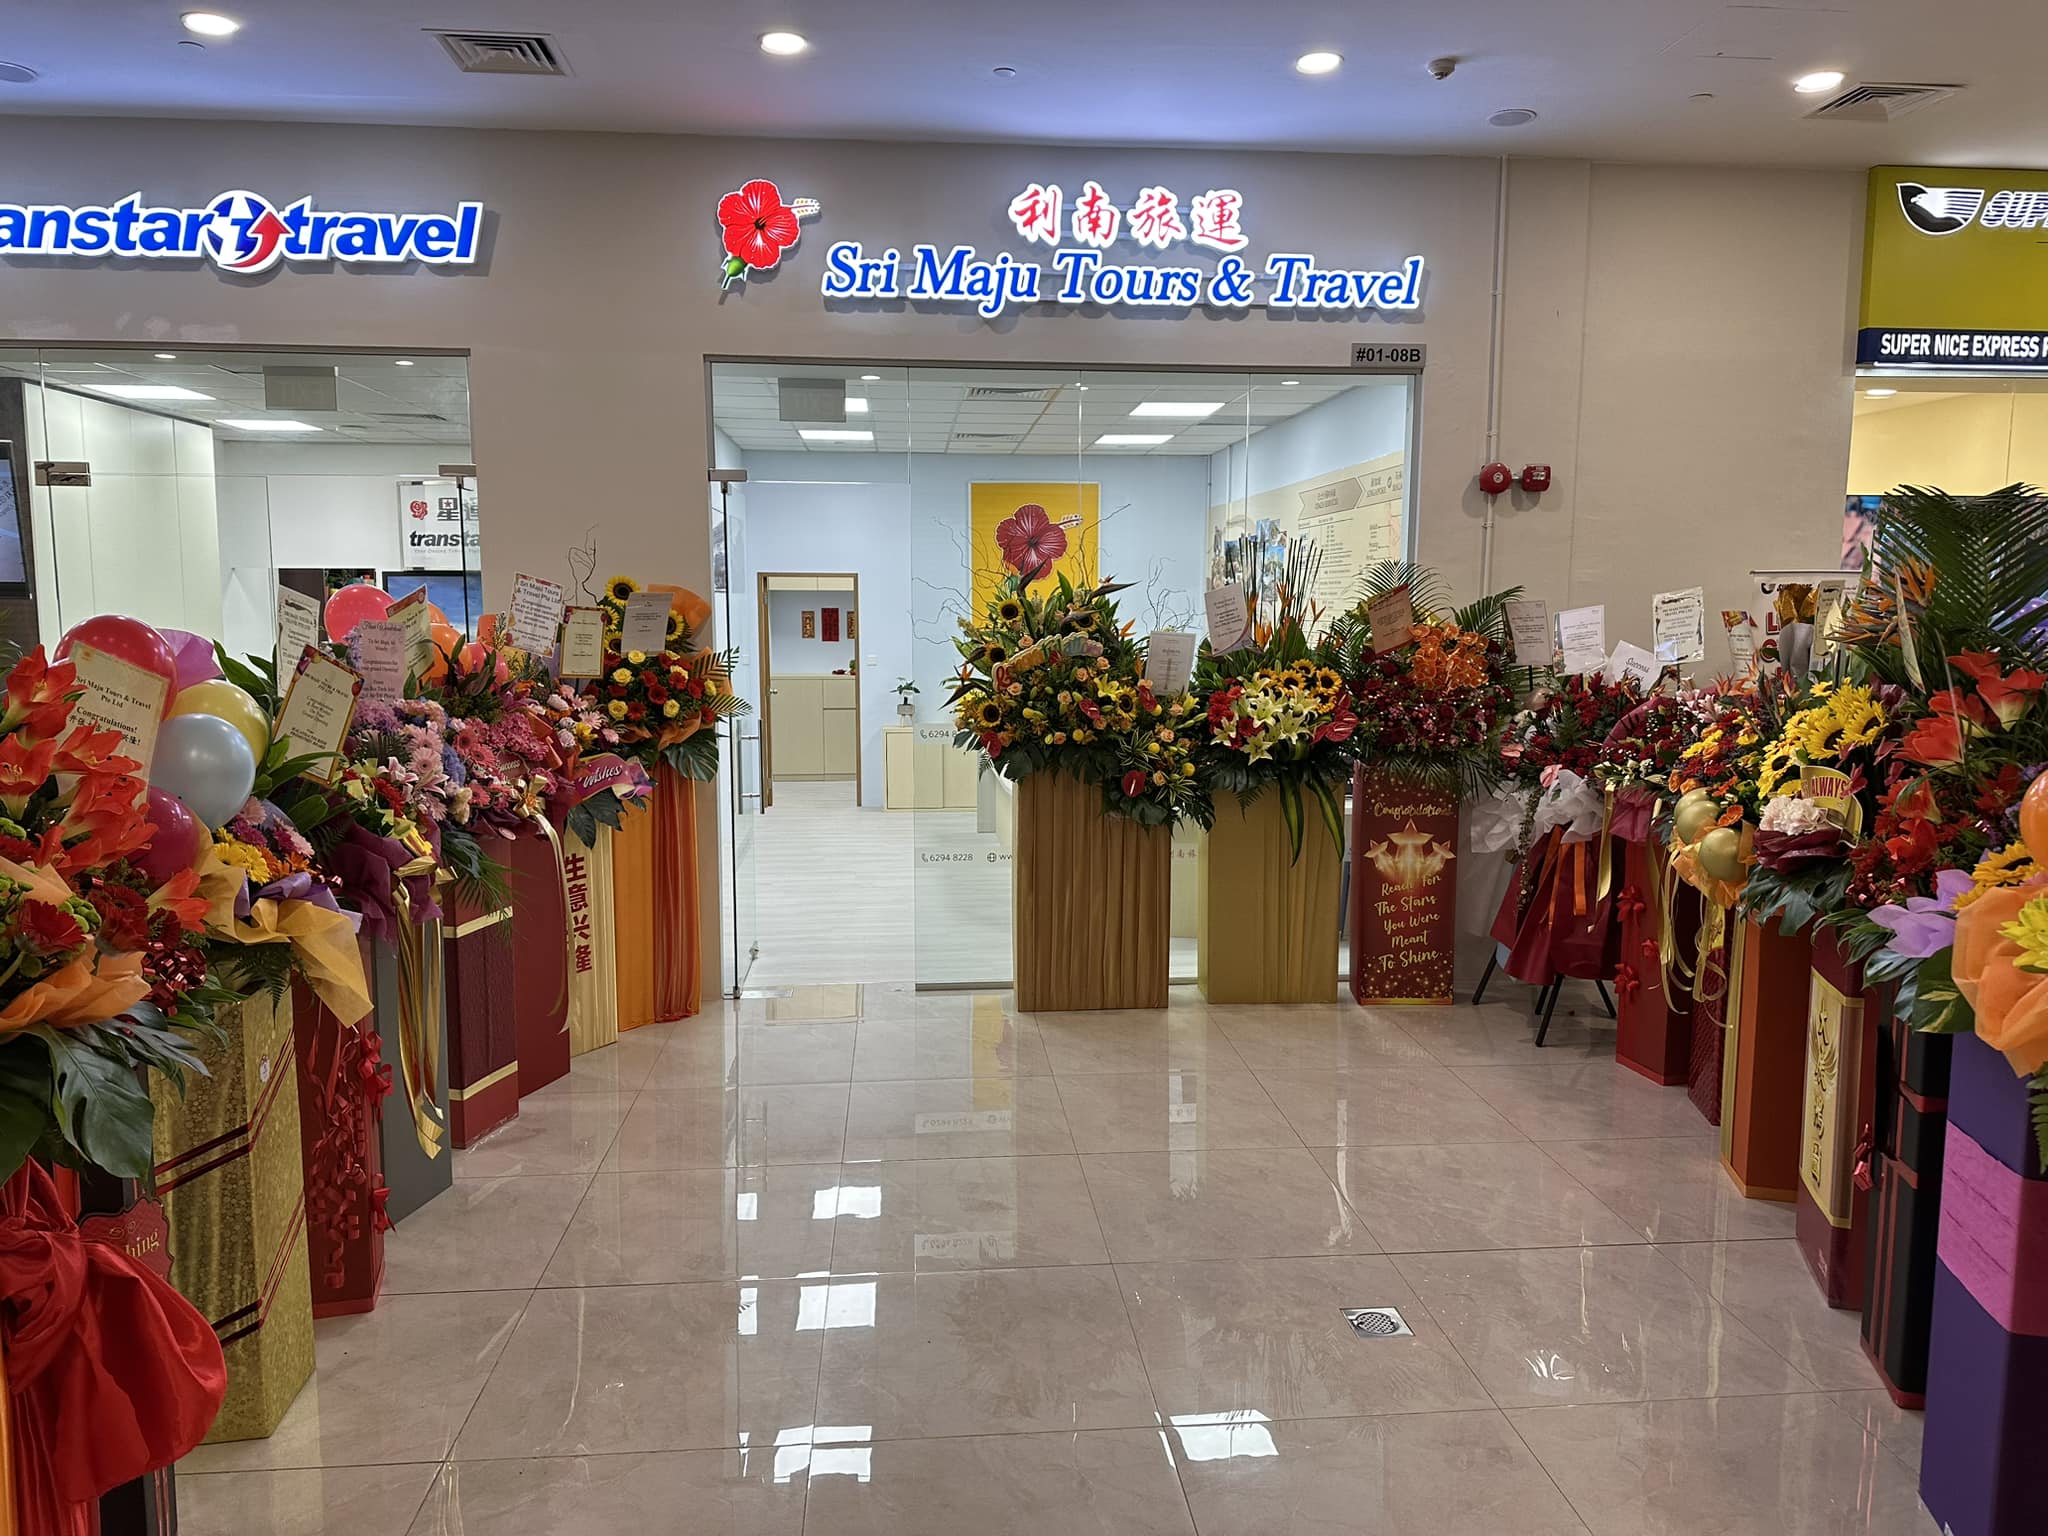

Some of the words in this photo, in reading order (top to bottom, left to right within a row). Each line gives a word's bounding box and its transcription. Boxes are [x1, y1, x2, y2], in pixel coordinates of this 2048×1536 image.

[1014, 185, 1244, 246] 利南旅運
[1980, 190, 2048, 229] SUP
[284, 196, 478, 260] travel
[826, 244, 899, 293] Sri
[911, 247, 1038, 314] Maju
[1056, 253, 1199, 301] Tours
[1211, 258, 1251, 302] &
[1268, 257, 1421, 305] Travel
[1355, 346, 1421, 363] #01-08B
[1880, 333, 1931, 355] SUPER
[1934, 334, 1970, 357] NICE
[1972, 335, 2040, 358] EXPRESS
[76, 676, 87, 685] Sri
[87, 679, 104, 692] Maju
[105, 686, 123, 699] Tours
[131, 697, 151, 710] Travel
[101, 694, 111, 704] Pte
[112, 699, 124, 709] Ltd
[76, 706, 139, 734] Congratulations!
[928, 729, 950, 738] 6294
[929, 852, 951, 862] 6294
[952, 852, 974, 862] 8228
[1381, 880, 1415, 897] Reach
[1374, 900, 1397, 917] The
[1400, 895, 1437, 914] Stars
[1383, 917, 1406, 936] You
[1409, 912, 1441, 929] Were
[1391, 929, 1432, 949] Meant
[1378, 953, 1395, 973] To
[1399, 949, 1441, 969] Shine
